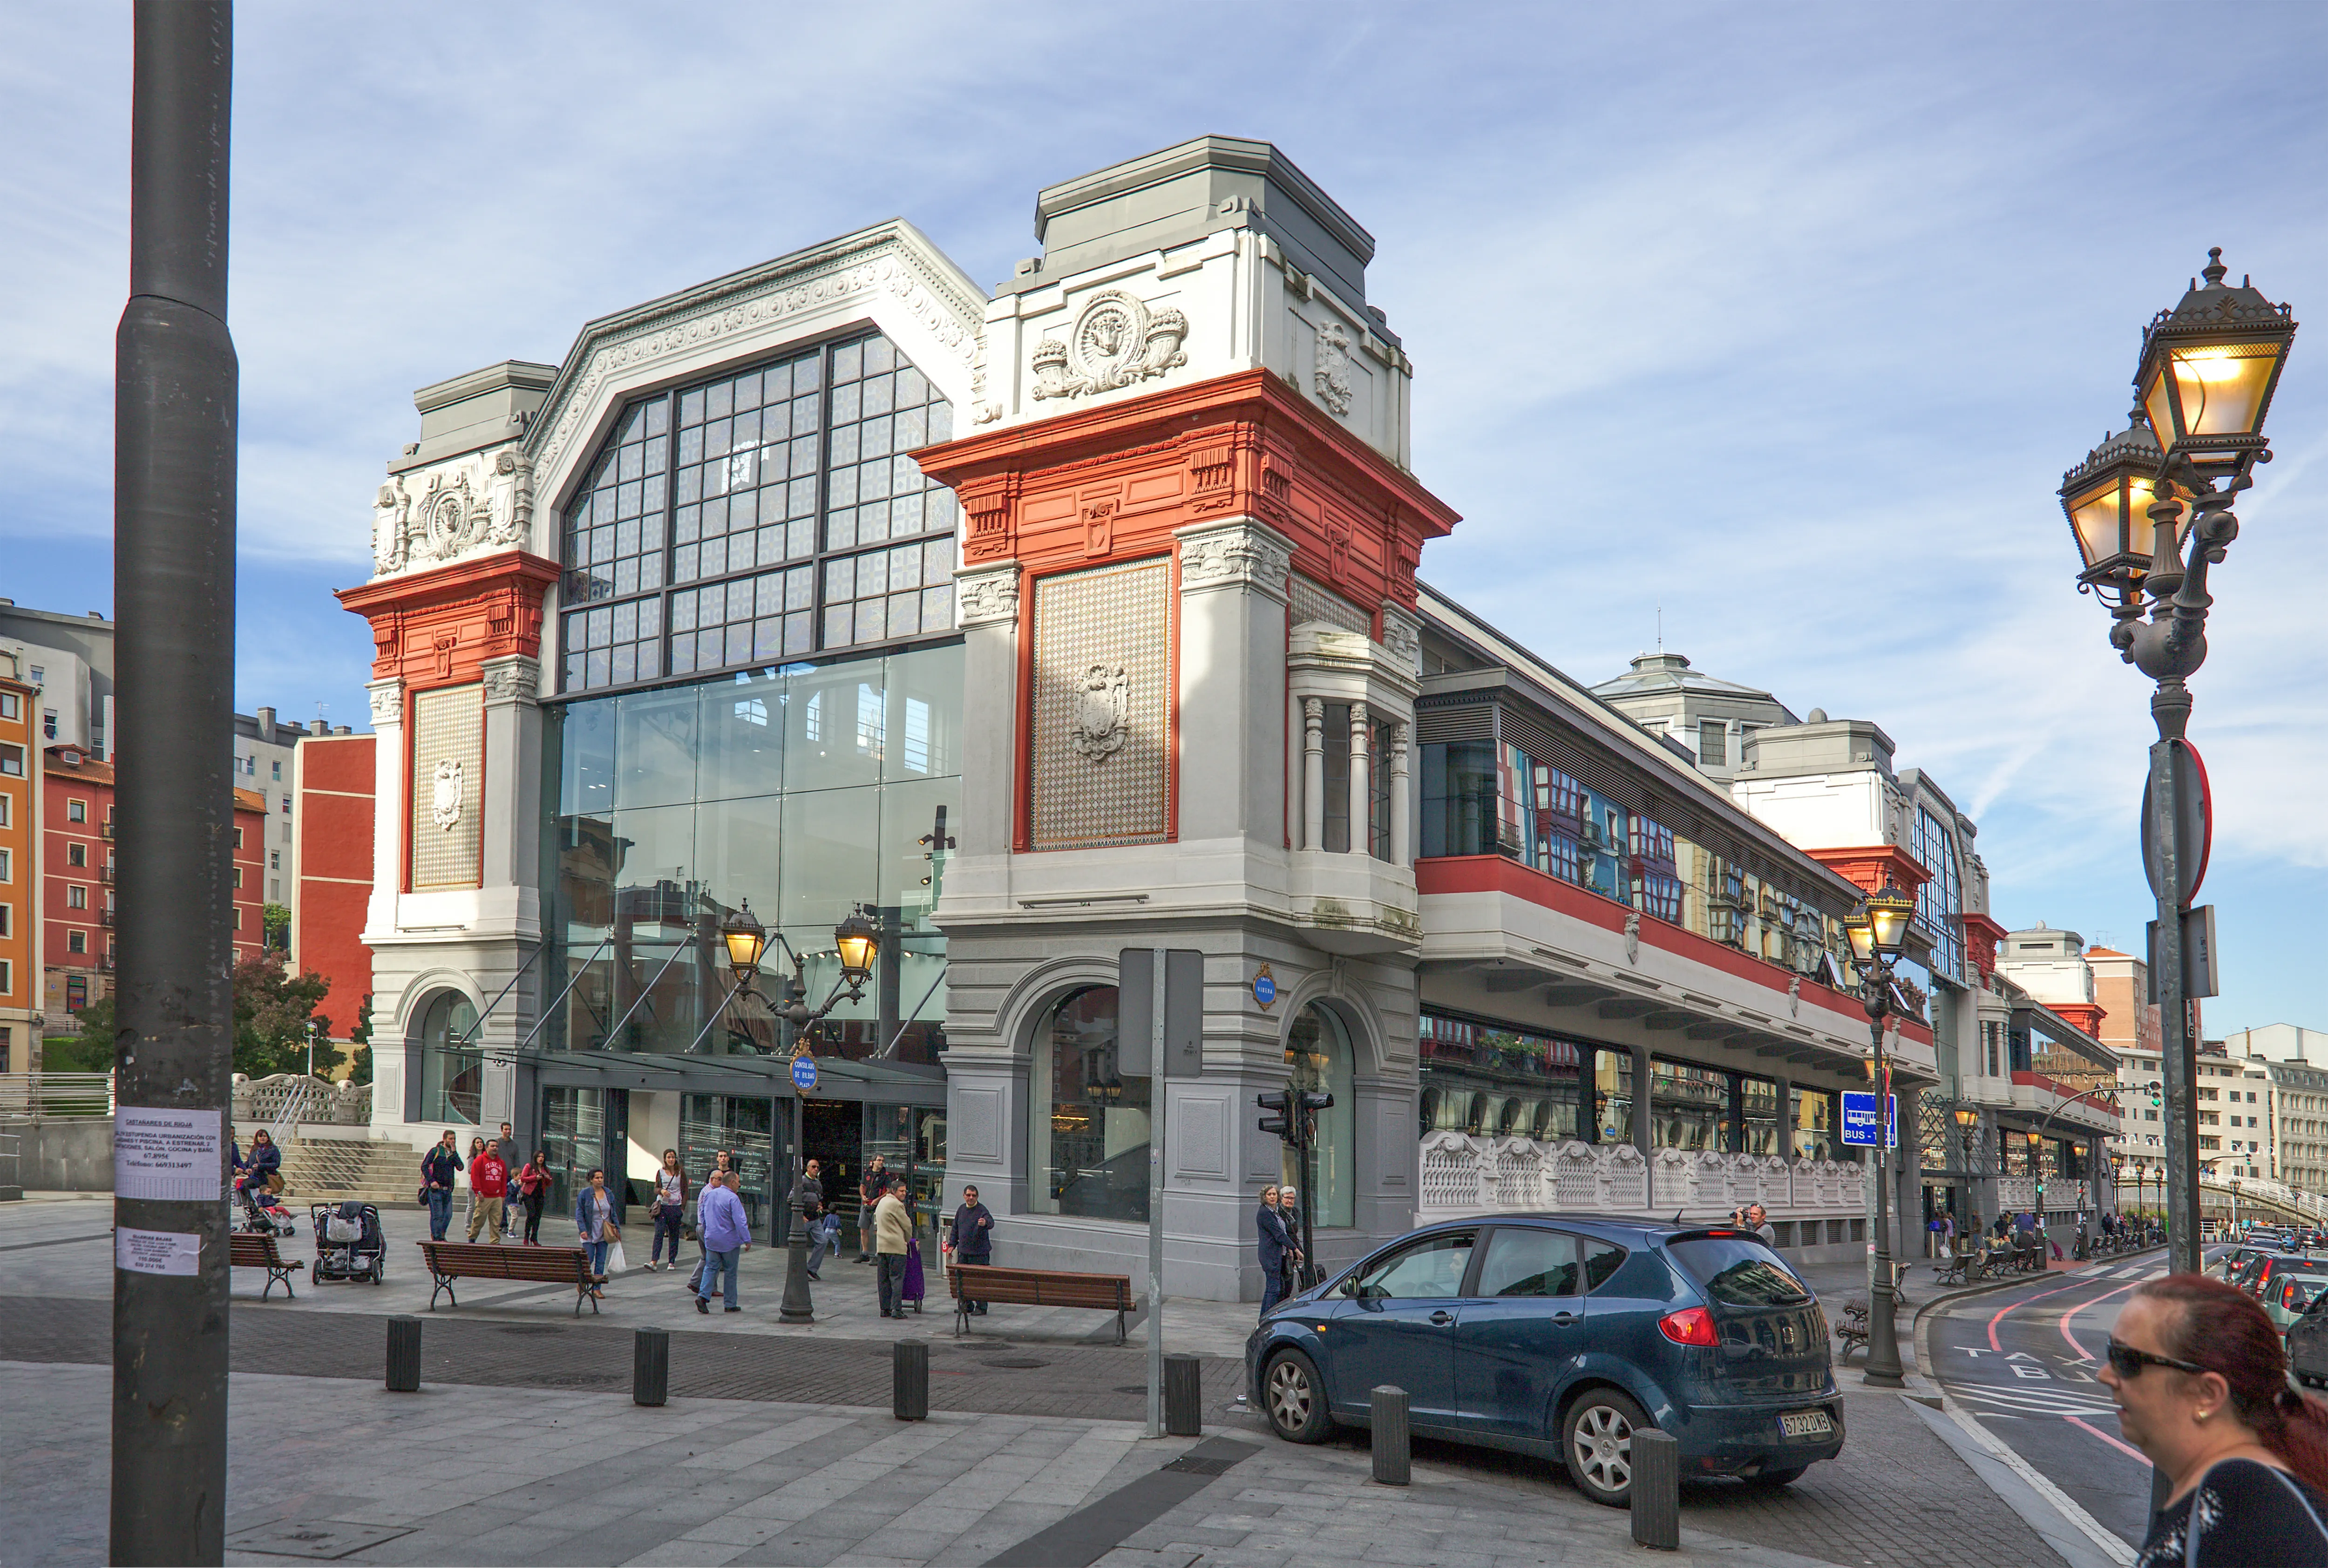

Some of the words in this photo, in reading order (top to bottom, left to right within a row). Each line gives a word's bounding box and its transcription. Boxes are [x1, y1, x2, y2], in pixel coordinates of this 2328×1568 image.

[1845, 1130, 1865, 1139] BUS
[1873, 1132, 1894, 1141] TXI
[2009, 1364, 2096, 1383] BU
